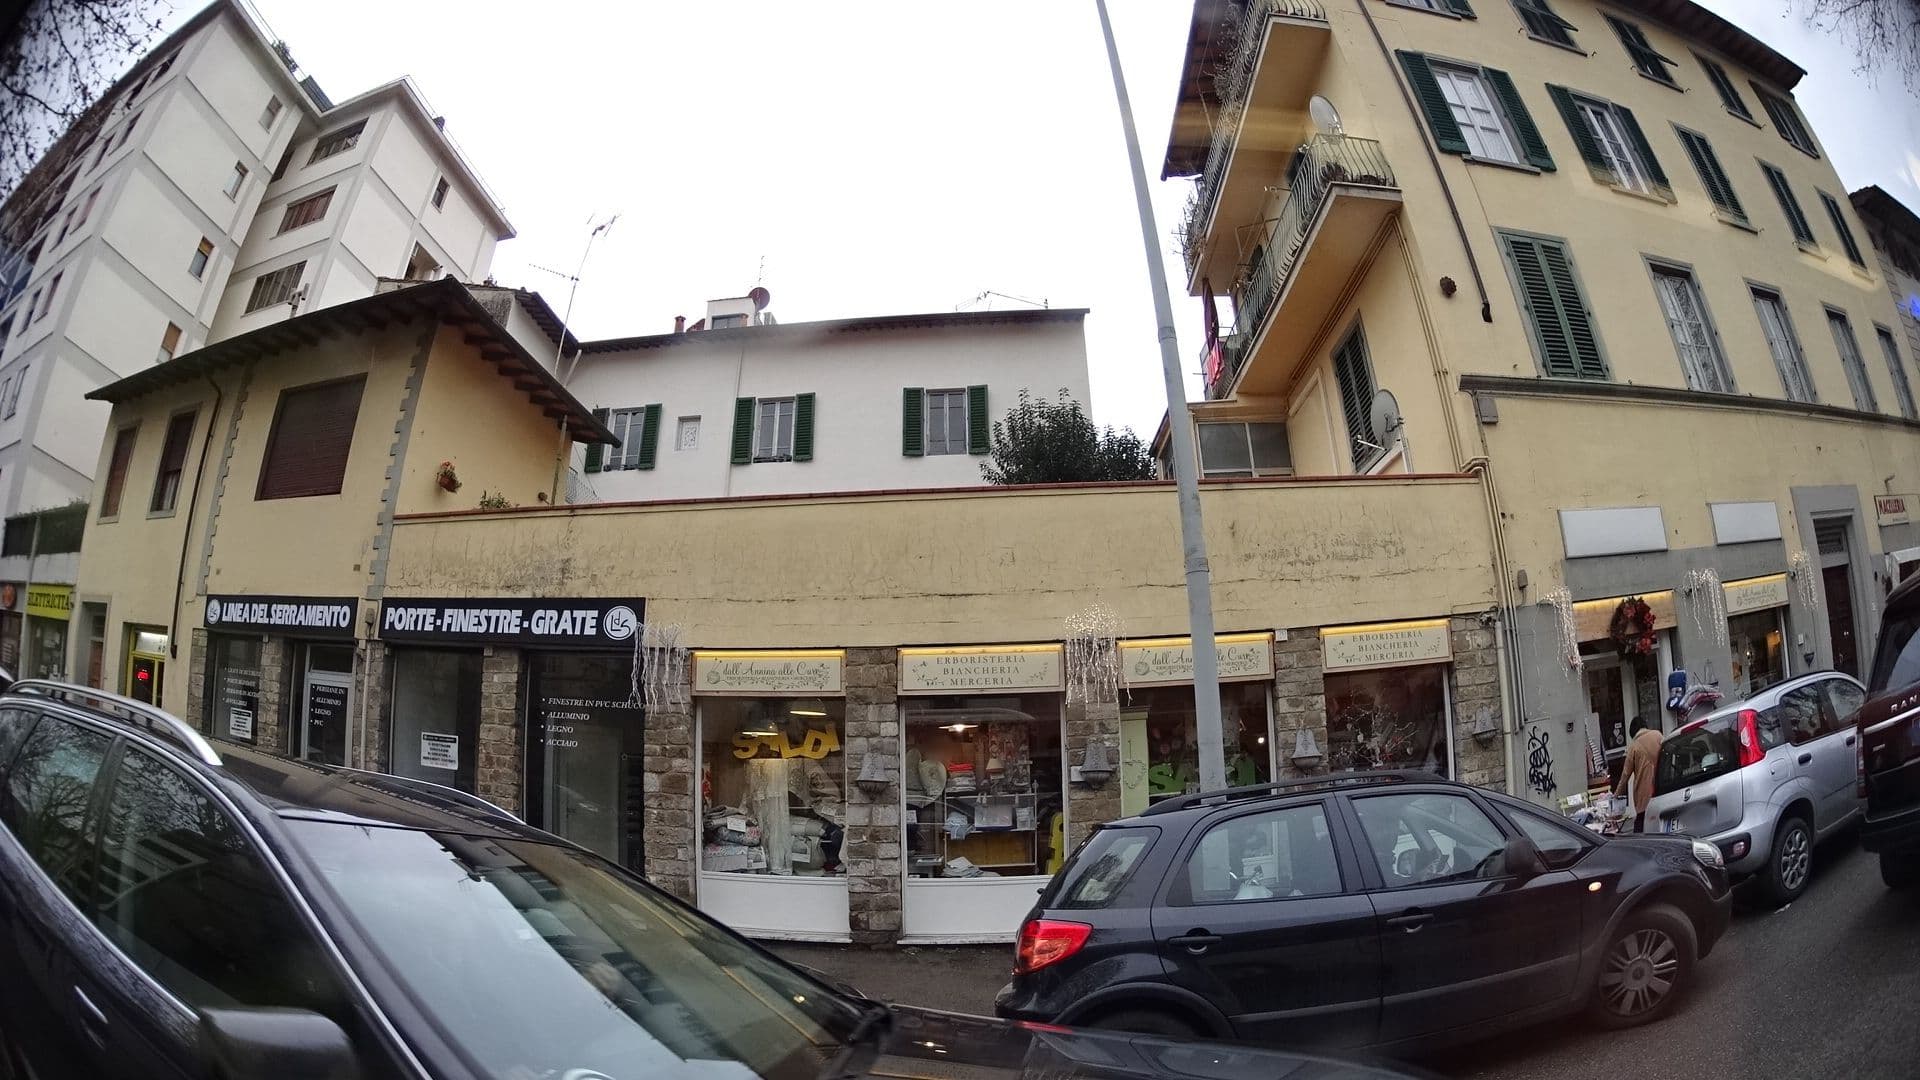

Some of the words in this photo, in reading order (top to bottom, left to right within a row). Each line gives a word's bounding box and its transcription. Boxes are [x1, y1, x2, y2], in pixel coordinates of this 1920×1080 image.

[222, 602, 250, 622] LINEA
[250, 603, 269, 624] DEL
[269, 604, 351, 627] SERRAMENTO
[1353, 630, 1423, 642] ERBORISTERIA
[1358, 640, 1419, 652] BIANCHERIA
[936, 655, 1026, 665] ERBORISTERIA
[1365, 651, 1414, 662] MERCERIA
[943, 666, 1020, 675] BIANCHERIA
[950, 677, 1013, 686] MERCERIA
[548, 697, 584, 707] FINESTRE
[585, 699, 595, 707] IN
[595, 700, 610, 708] PVC
[547, 711, 590, 720] ALLUMINIO
[546, 725, 574, 734] LEGNO
[546, 739, 578, 748] ACCIAIO
